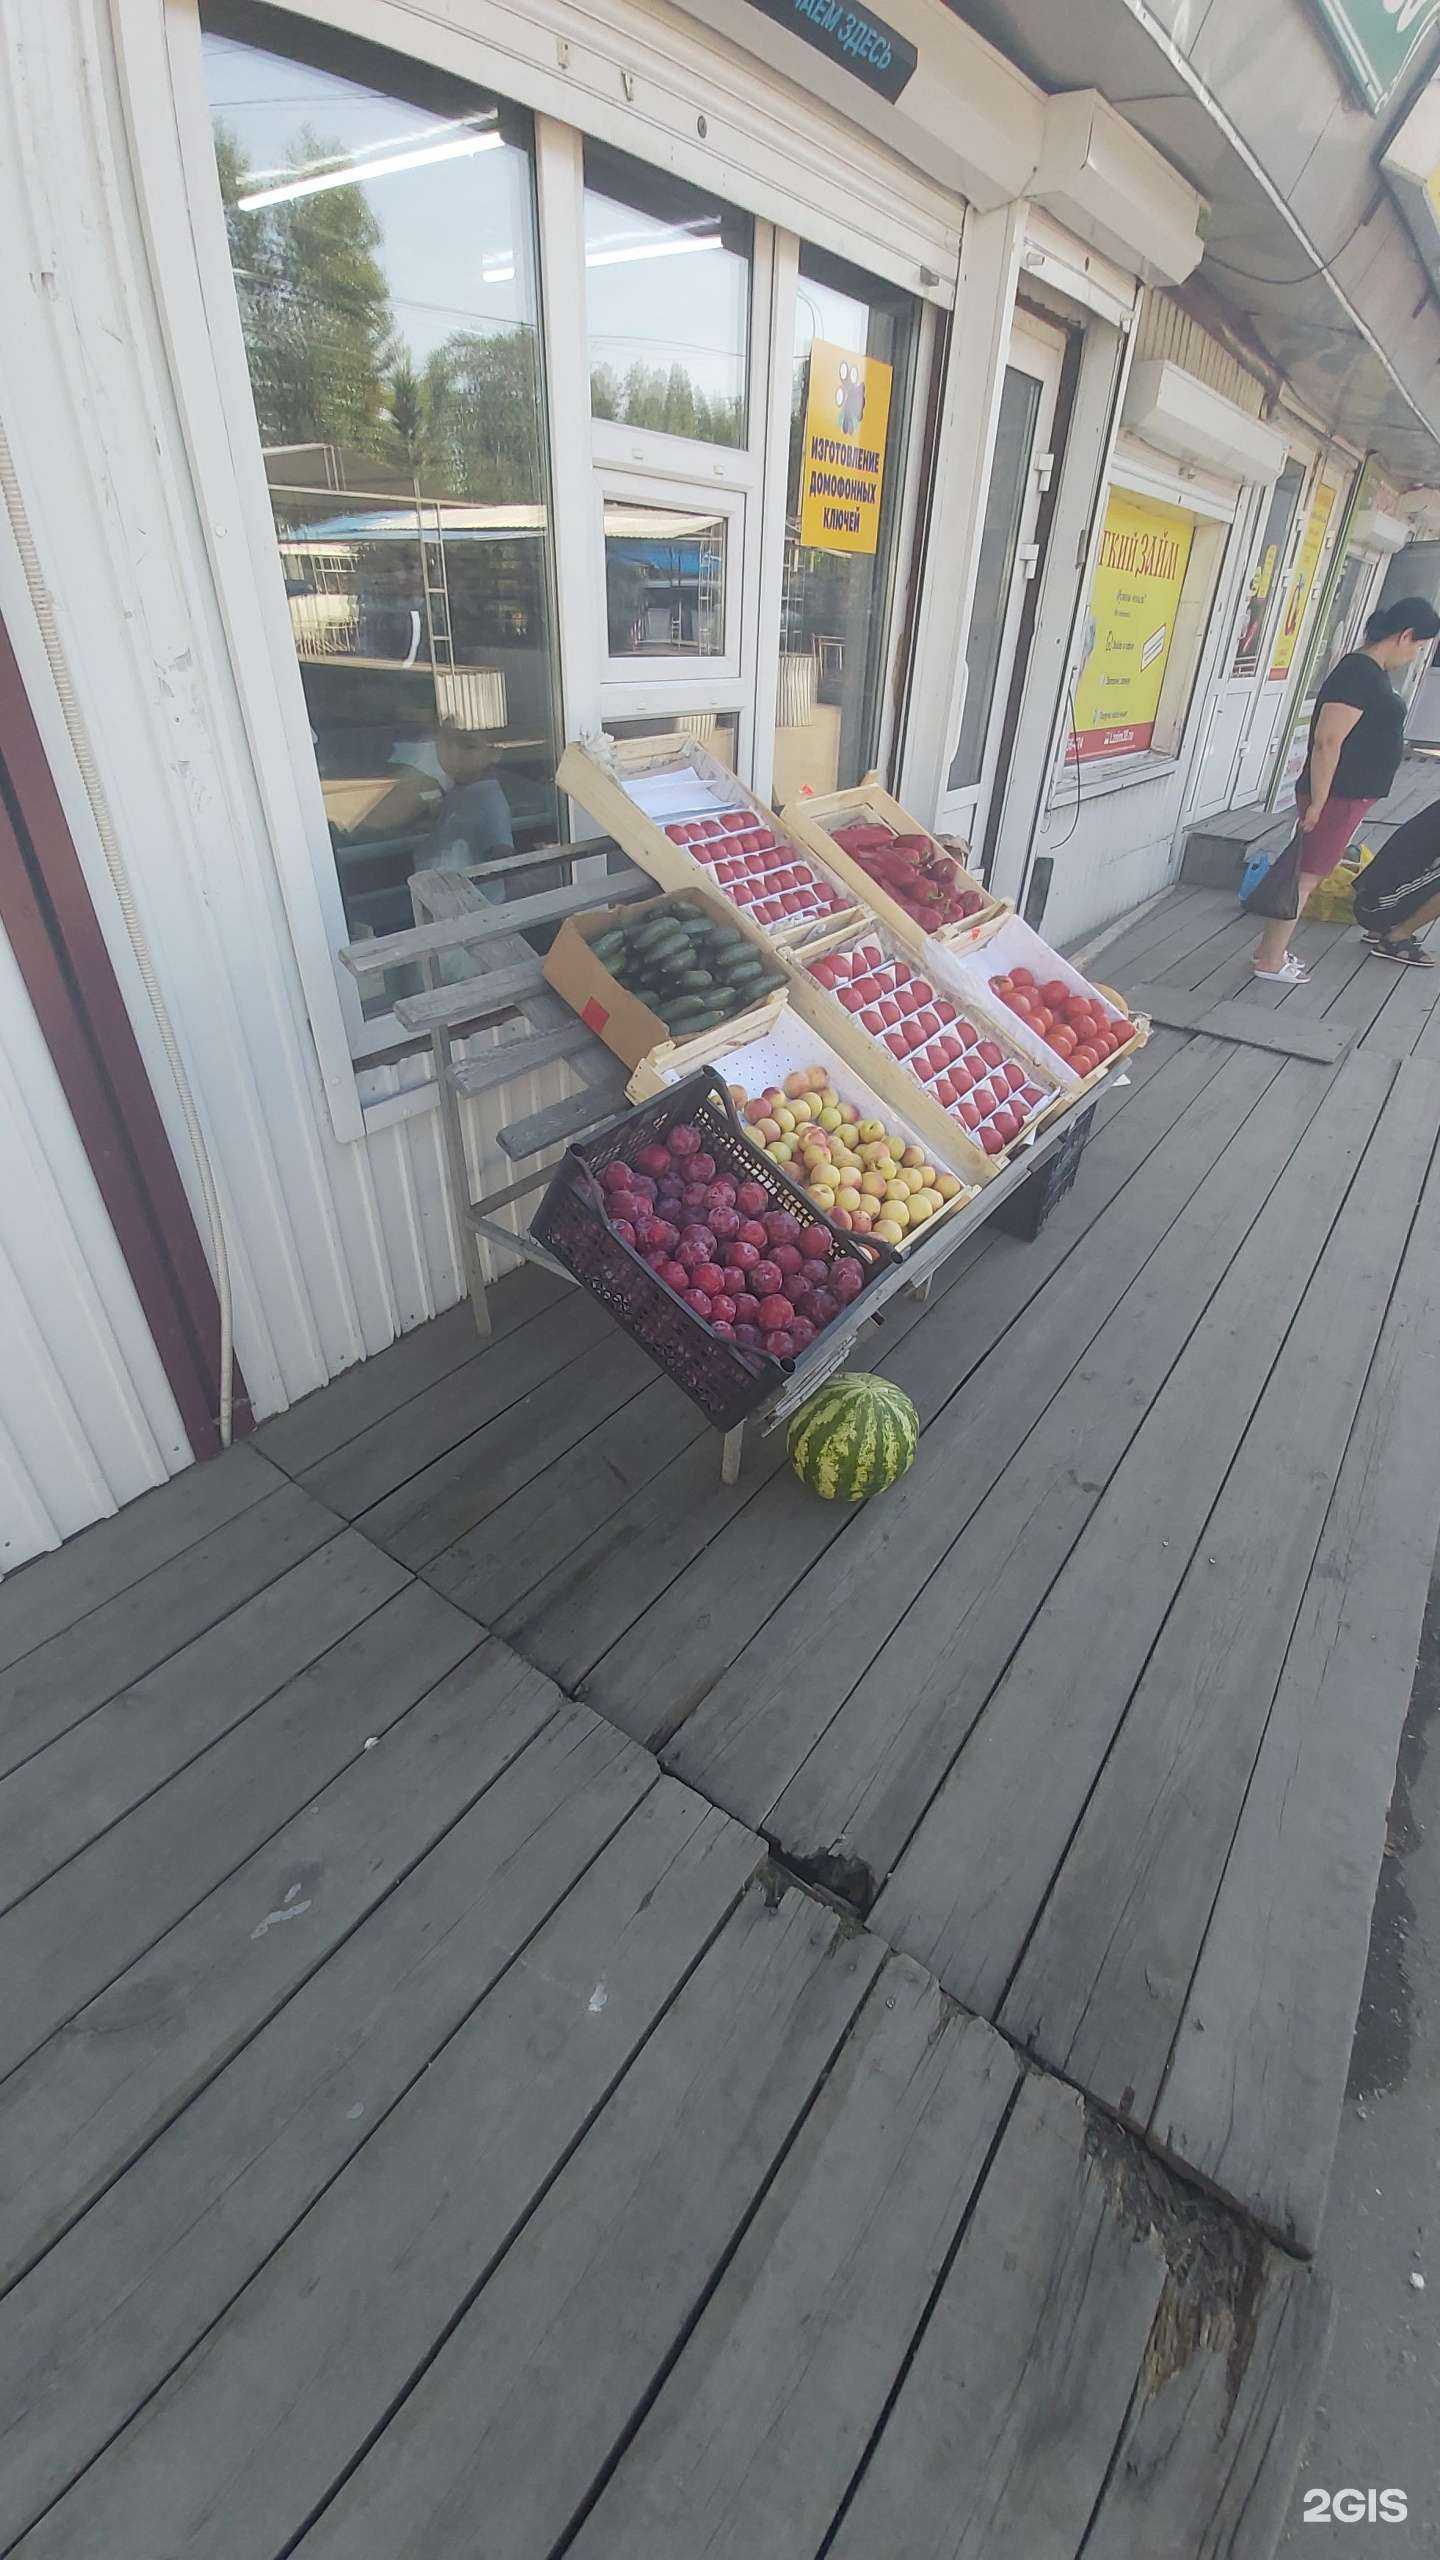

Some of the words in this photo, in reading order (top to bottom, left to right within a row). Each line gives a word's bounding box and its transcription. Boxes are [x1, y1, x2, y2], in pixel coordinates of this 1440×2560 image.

[838, 13, 891, 70] ЗДЕСЬ
[811, 435, 880, 474] ИЗГОТОВЛЕНИЕ
[809, 470, 877, 504] ДОМОФОННЫХ
[823, 505, 861, 534] КЛЮЧЕЙ
[1097, 529, 1139, 573] ГКИЙ
[1134, 528, 1179, 580] ЗАЙМ
